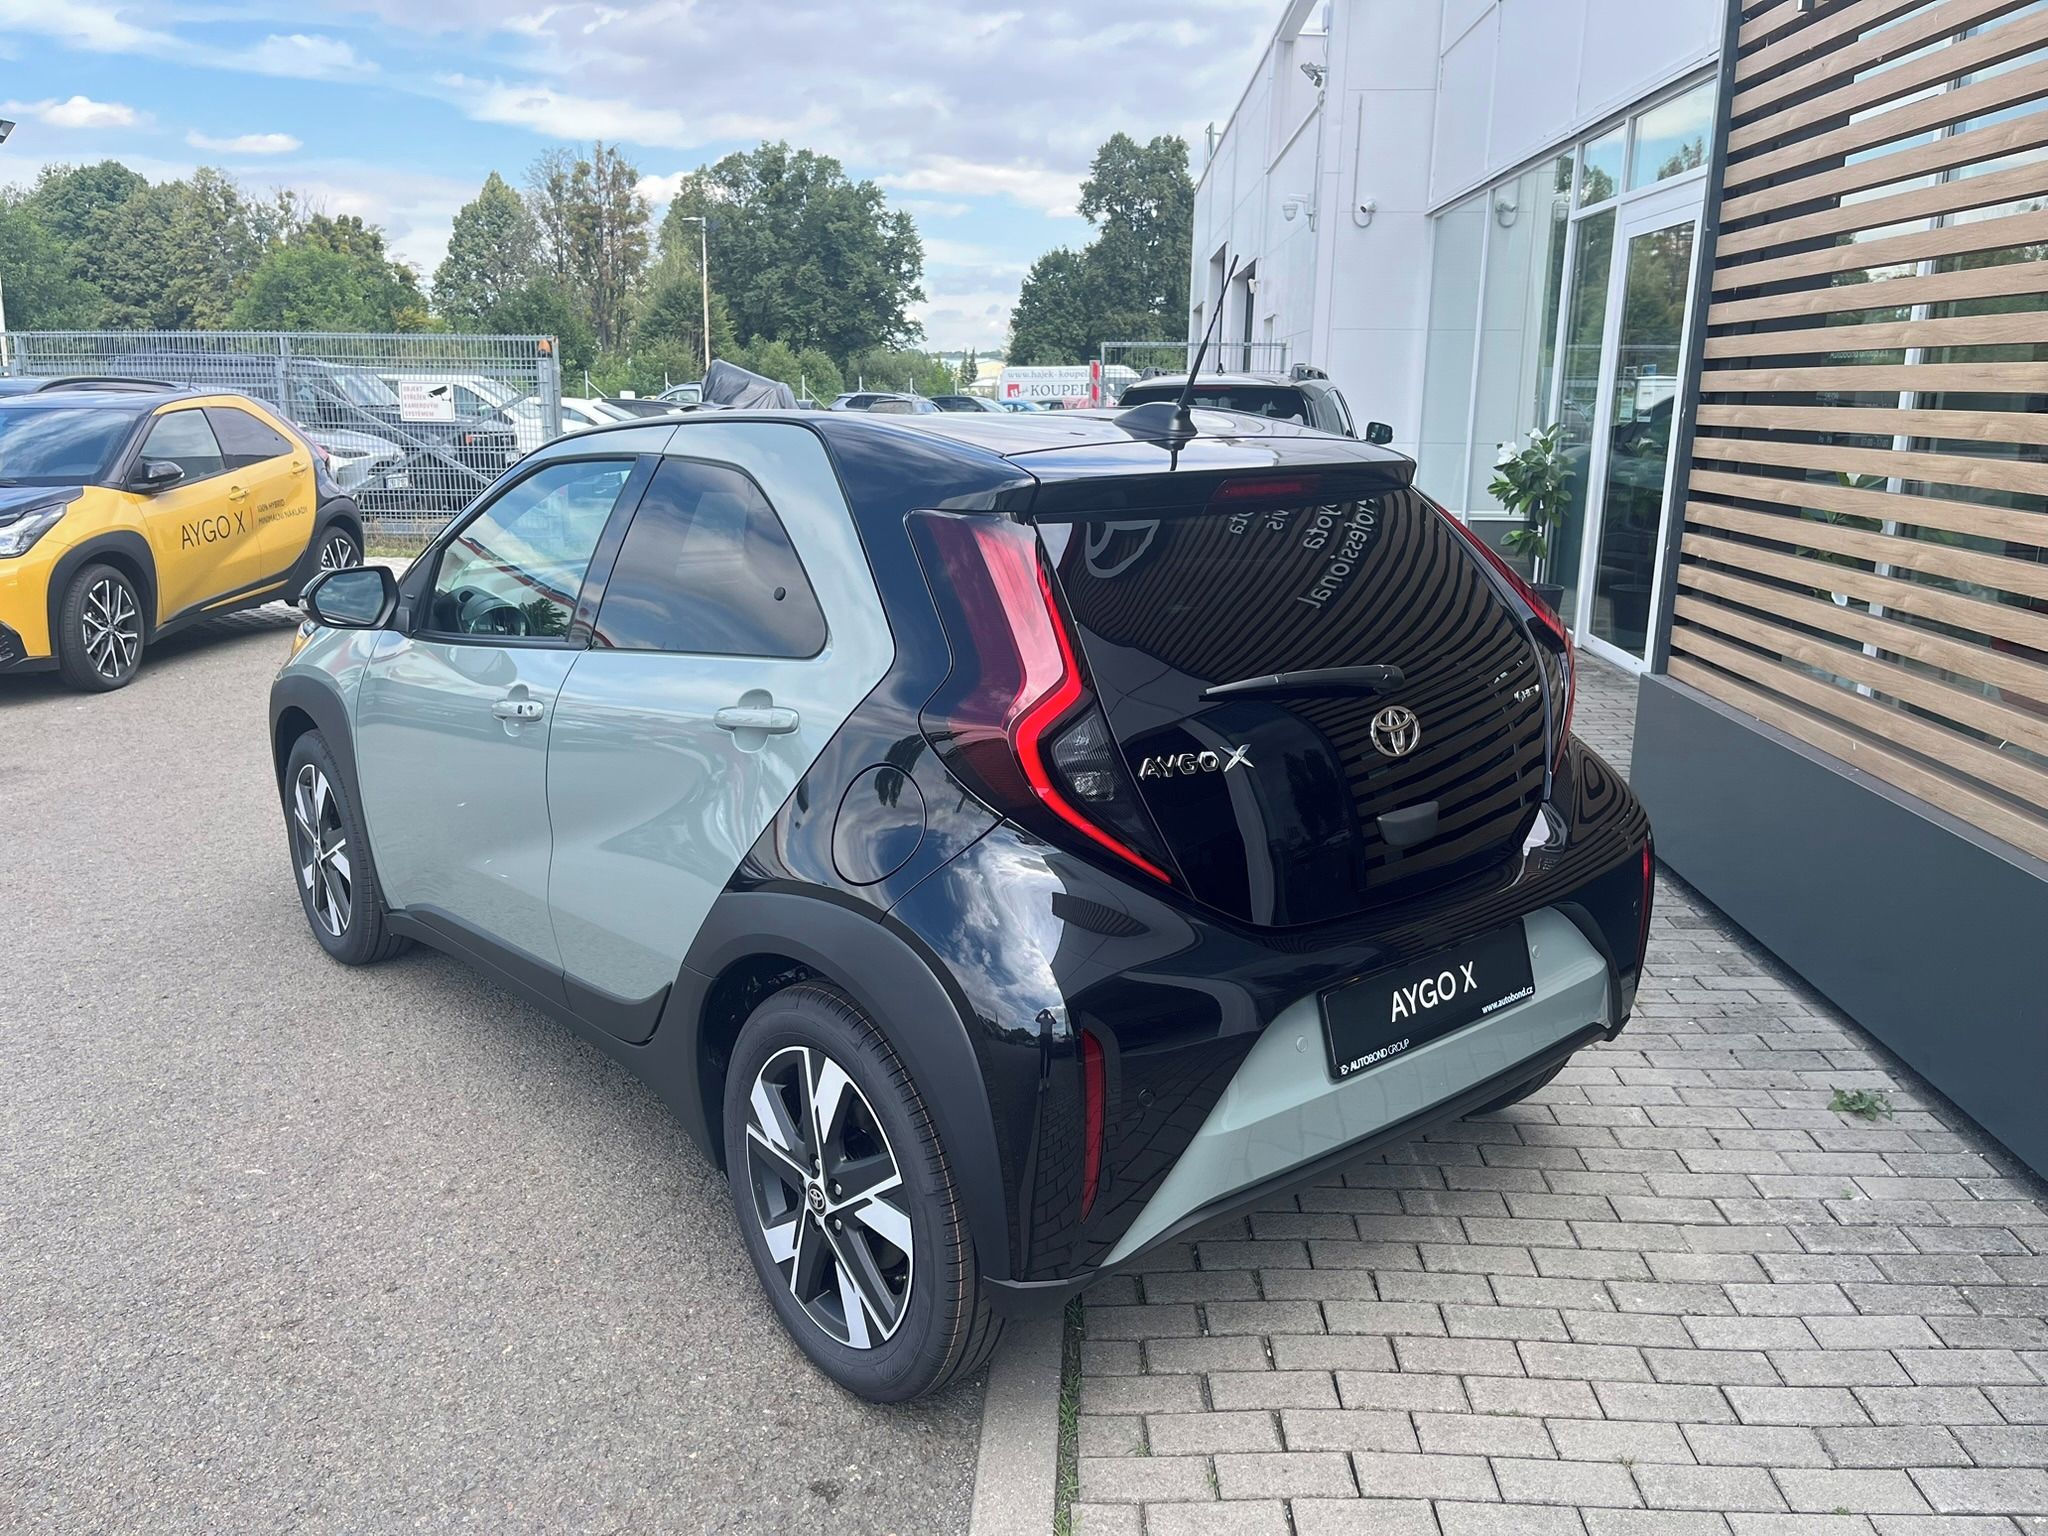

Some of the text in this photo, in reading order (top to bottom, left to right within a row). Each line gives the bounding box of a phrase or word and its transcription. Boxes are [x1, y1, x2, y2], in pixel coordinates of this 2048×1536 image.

[1007, 368, 1089, 379] www.hajek-koupel
[1030, 384, 1090, 397] KOUPEL
[181, 510, 246, 550] AYGO X
[1138, 743, 1255, 780] AYGO X
[1391, 960, 1478, 1023] AYGO X
[1481, 986, 1534, 1014] www.autobond.cz
[1349, 1038, 1410, 1072] AUTOBOND GROUP
